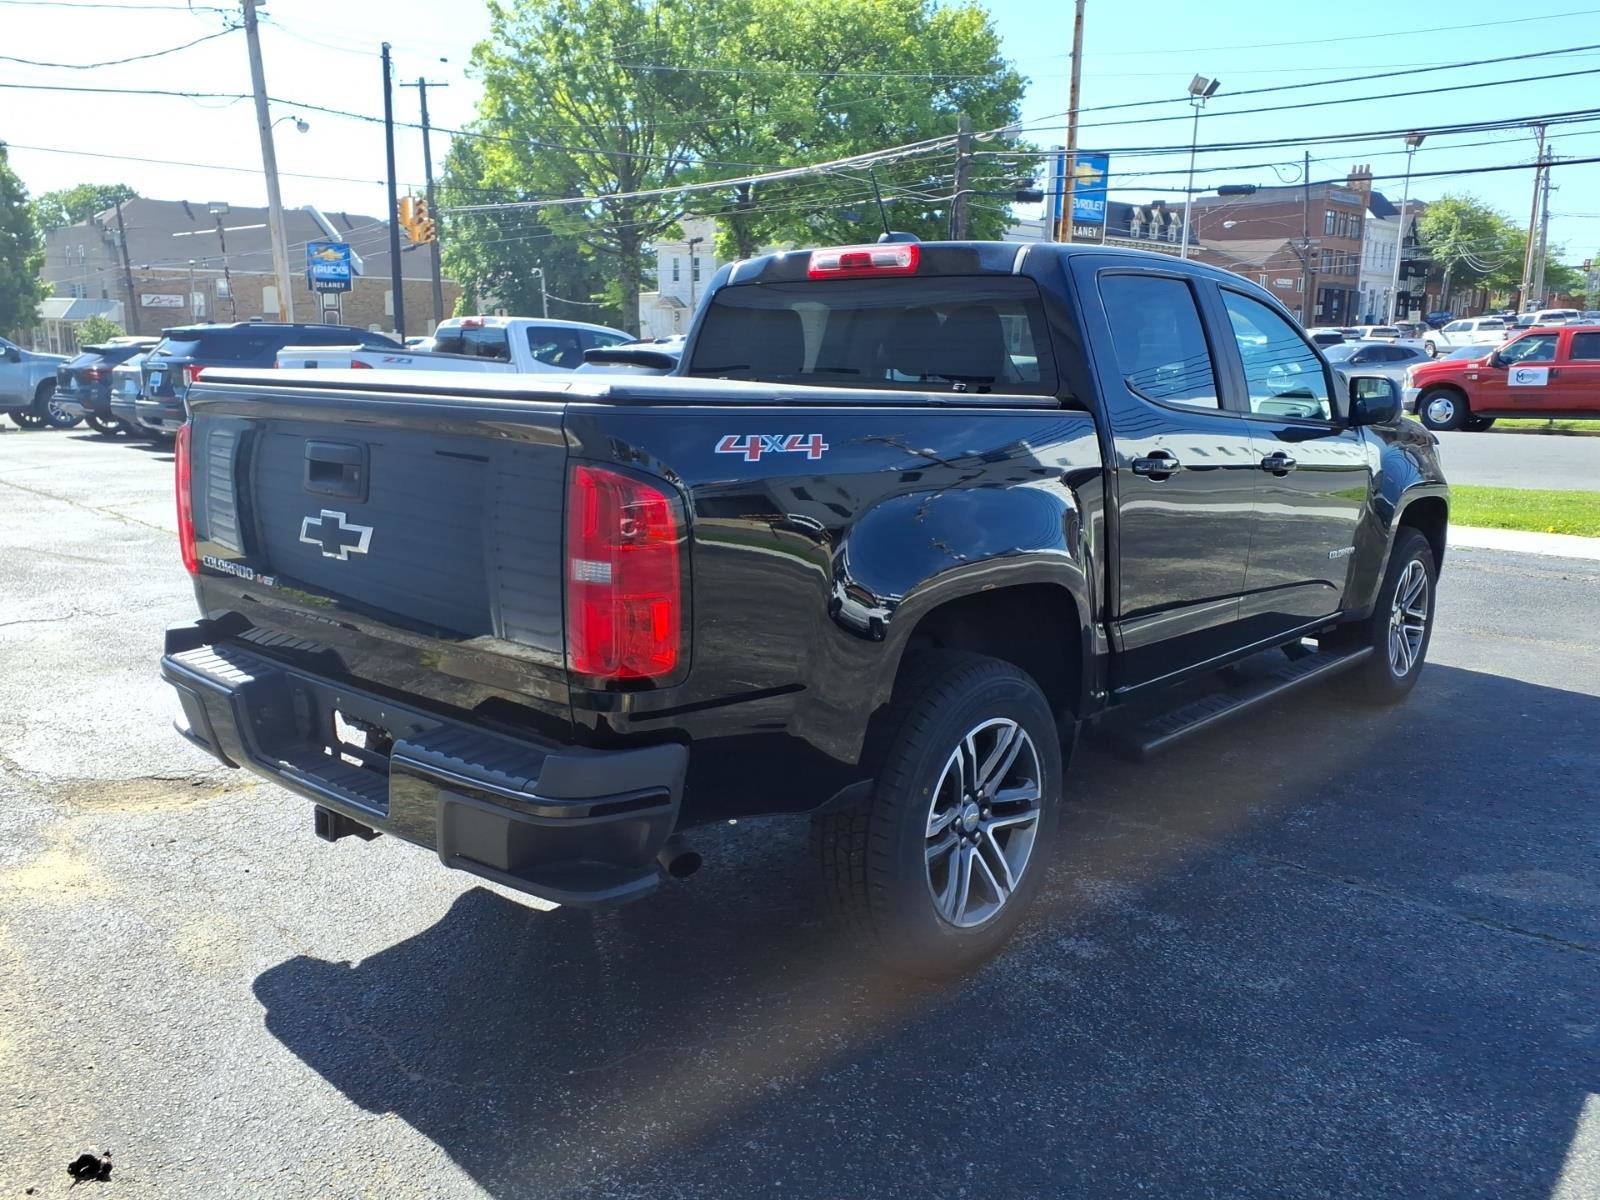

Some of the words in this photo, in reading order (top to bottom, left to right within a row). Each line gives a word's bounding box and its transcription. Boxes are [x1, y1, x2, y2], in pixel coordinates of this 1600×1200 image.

[1072, 198, 1105, 211] EVROLET
[1072, 225, 1098, 237] LANEY
[202, 555, 254, 580] COLORADO
